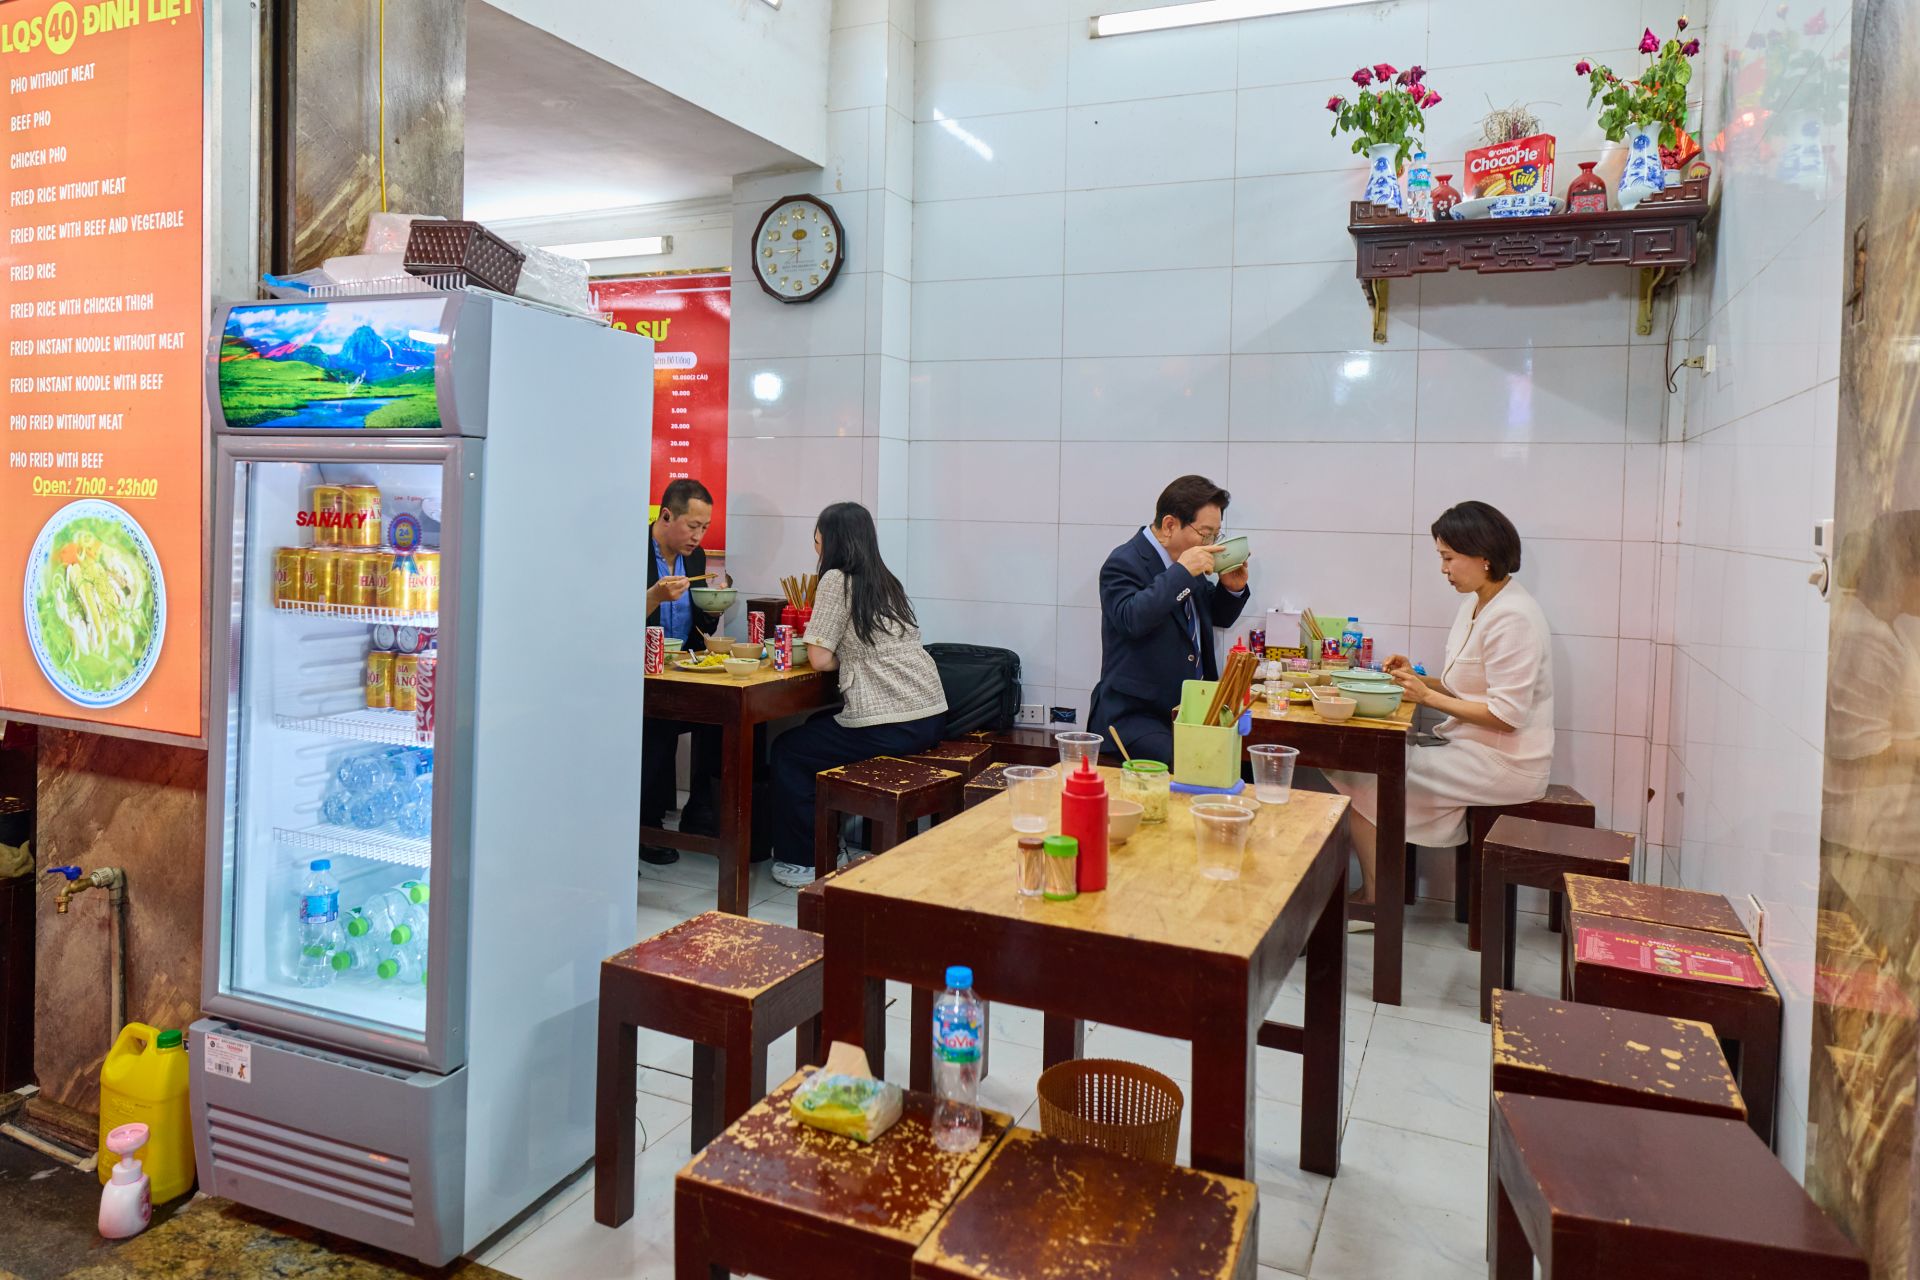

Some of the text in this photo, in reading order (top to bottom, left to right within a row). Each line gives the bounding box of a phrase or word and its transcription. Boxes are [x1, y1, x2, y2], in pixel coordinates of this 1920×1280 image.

[82, 0, 140, 36] ĐINH
[10, 63, 95, 94] PHO WITHOUT MEAT
[10, 110, 51, 132] BEEF PHO
[10, 146, 67, 169] CHICKEN PHO
[1470, 148, 1538, 173] ChocoPie
[10, 177, 126, 207] FRIED RICE WITHOUT MEAT
[10, 210, 184, 244] FRIED RICE WITH BEEF AND VEGETABLE
[10, 262, 56, 281] FRIED RICE
[10, 293, 154, 319] FRIED RICE WITH CHICKEN THIGH
[10, 331, 185, 356] FRIED INSTANT NOODLE WITHOUT MEAT
[10, 373, 164, 393] FRIED INSTANT NOODLE WITH BEEF
[10, 413, 123, 431] PHO FRIED WITHOUT MEAT
[10, 452, 104, 469] PHO FRIED WITH BEEF
[33, 476, 71, 496] Open:
[74, 477, 106, 495] 7h00
[116, 478, 158, 497] 23h00
[296, 511, 368, 529] SANAKY
